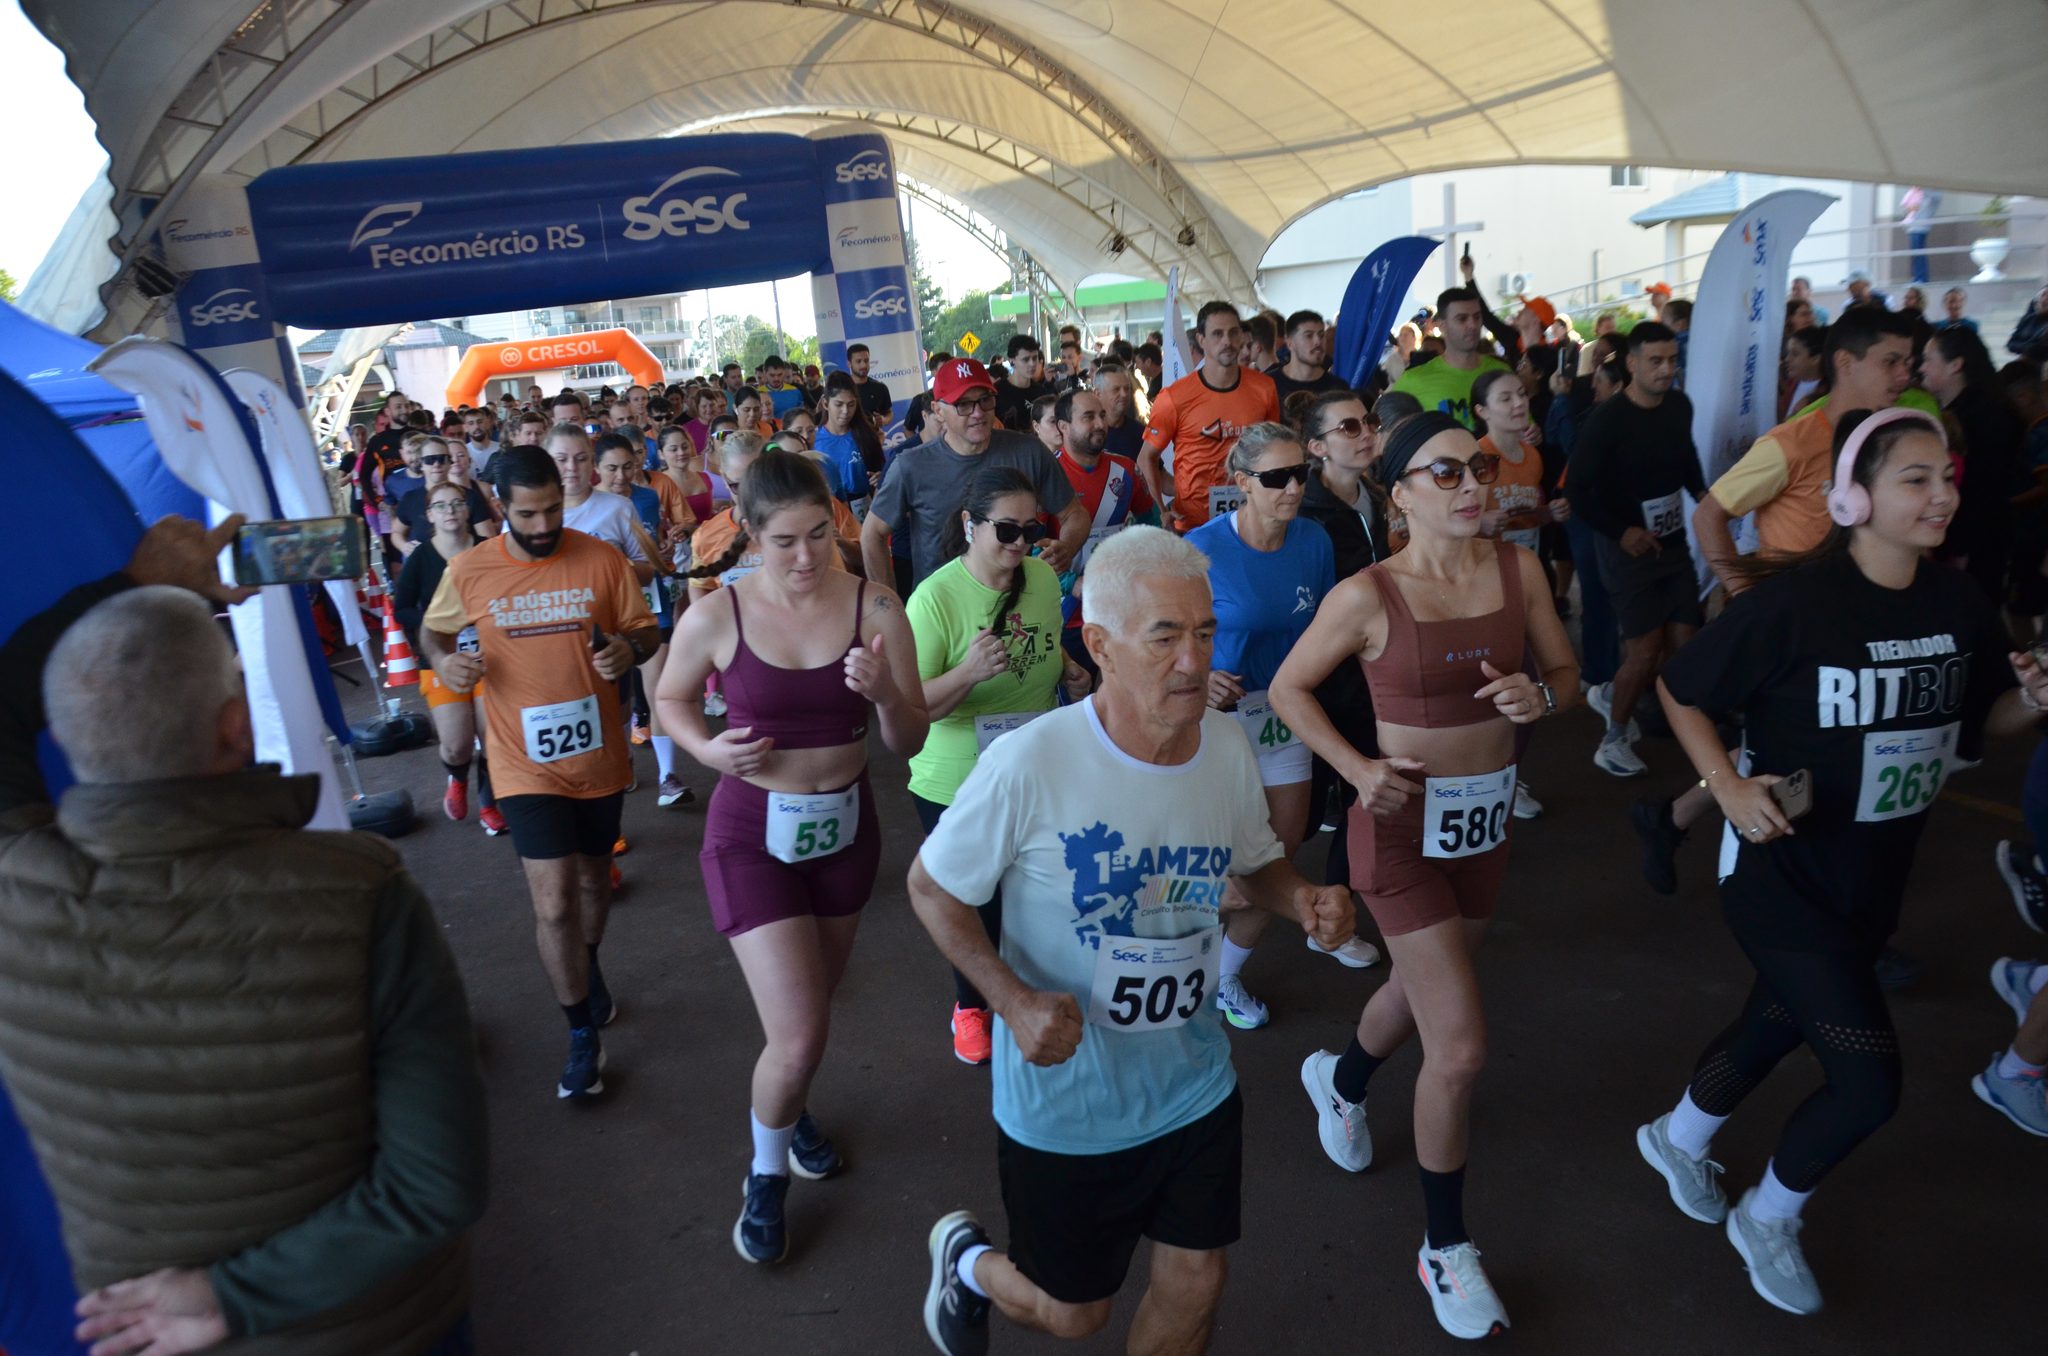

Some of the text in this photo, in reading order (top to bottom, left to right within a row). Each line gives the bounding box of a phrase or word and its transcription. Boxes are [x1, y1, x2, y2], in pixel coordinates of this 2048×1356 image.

[235, 226, 250, 237] RS
[841, 233, 891, 248] Fecomércio
[370, 224, 586, 269] Fecomércio RS
[528, 340, 603, 362] CRESOL
[870, 367, 912, 379] ecomércio
[513, 588, 596, 610] RÚSTICA
[496, 603, 592, 627] REGIONAL
[1458, 648, 1490, 660] LURK
[1866, 633, 1957, 661] TREINADOR
[1818, 655, 1968, 728] RITBO
[538, 720, 592, 758] 529
[1873, 758, 1942, 814] 263
[795, 818, 839, 856] 53
[1439, 801, 1505, 853] 580
[1109, 969, 1205, 1026] 503
